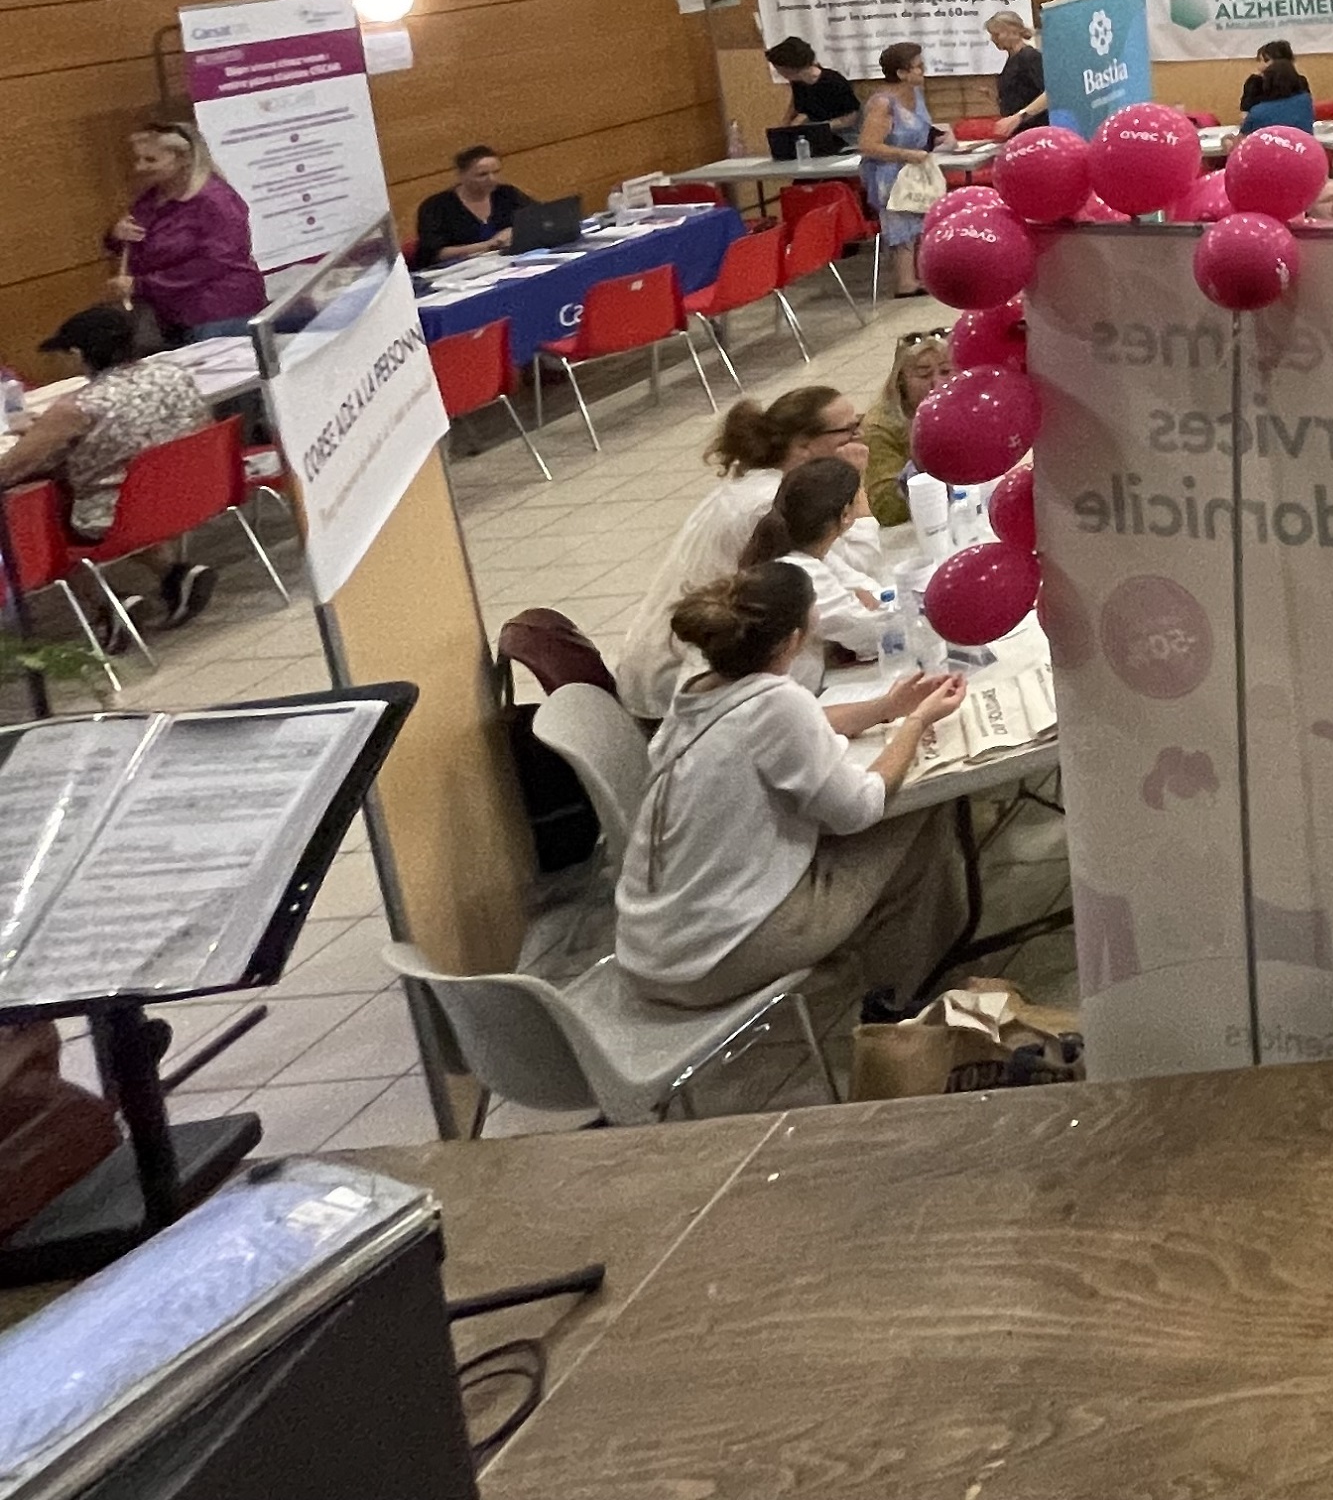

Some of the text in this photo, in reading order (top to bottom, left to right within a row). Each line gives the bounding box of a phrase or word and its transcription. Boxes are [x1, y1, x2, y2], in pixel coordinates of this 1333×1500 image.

[1082, 57, 1129, 96] Bastia
[1004, 137, 1056, 162] avec.fr
[1119, 129, 1181, 147] avec.fr
[1260, 131, 1307, 155] avec.fr
[558, 303, 585, 328] Ca
[373, 323, 427, 388] PERSONN
